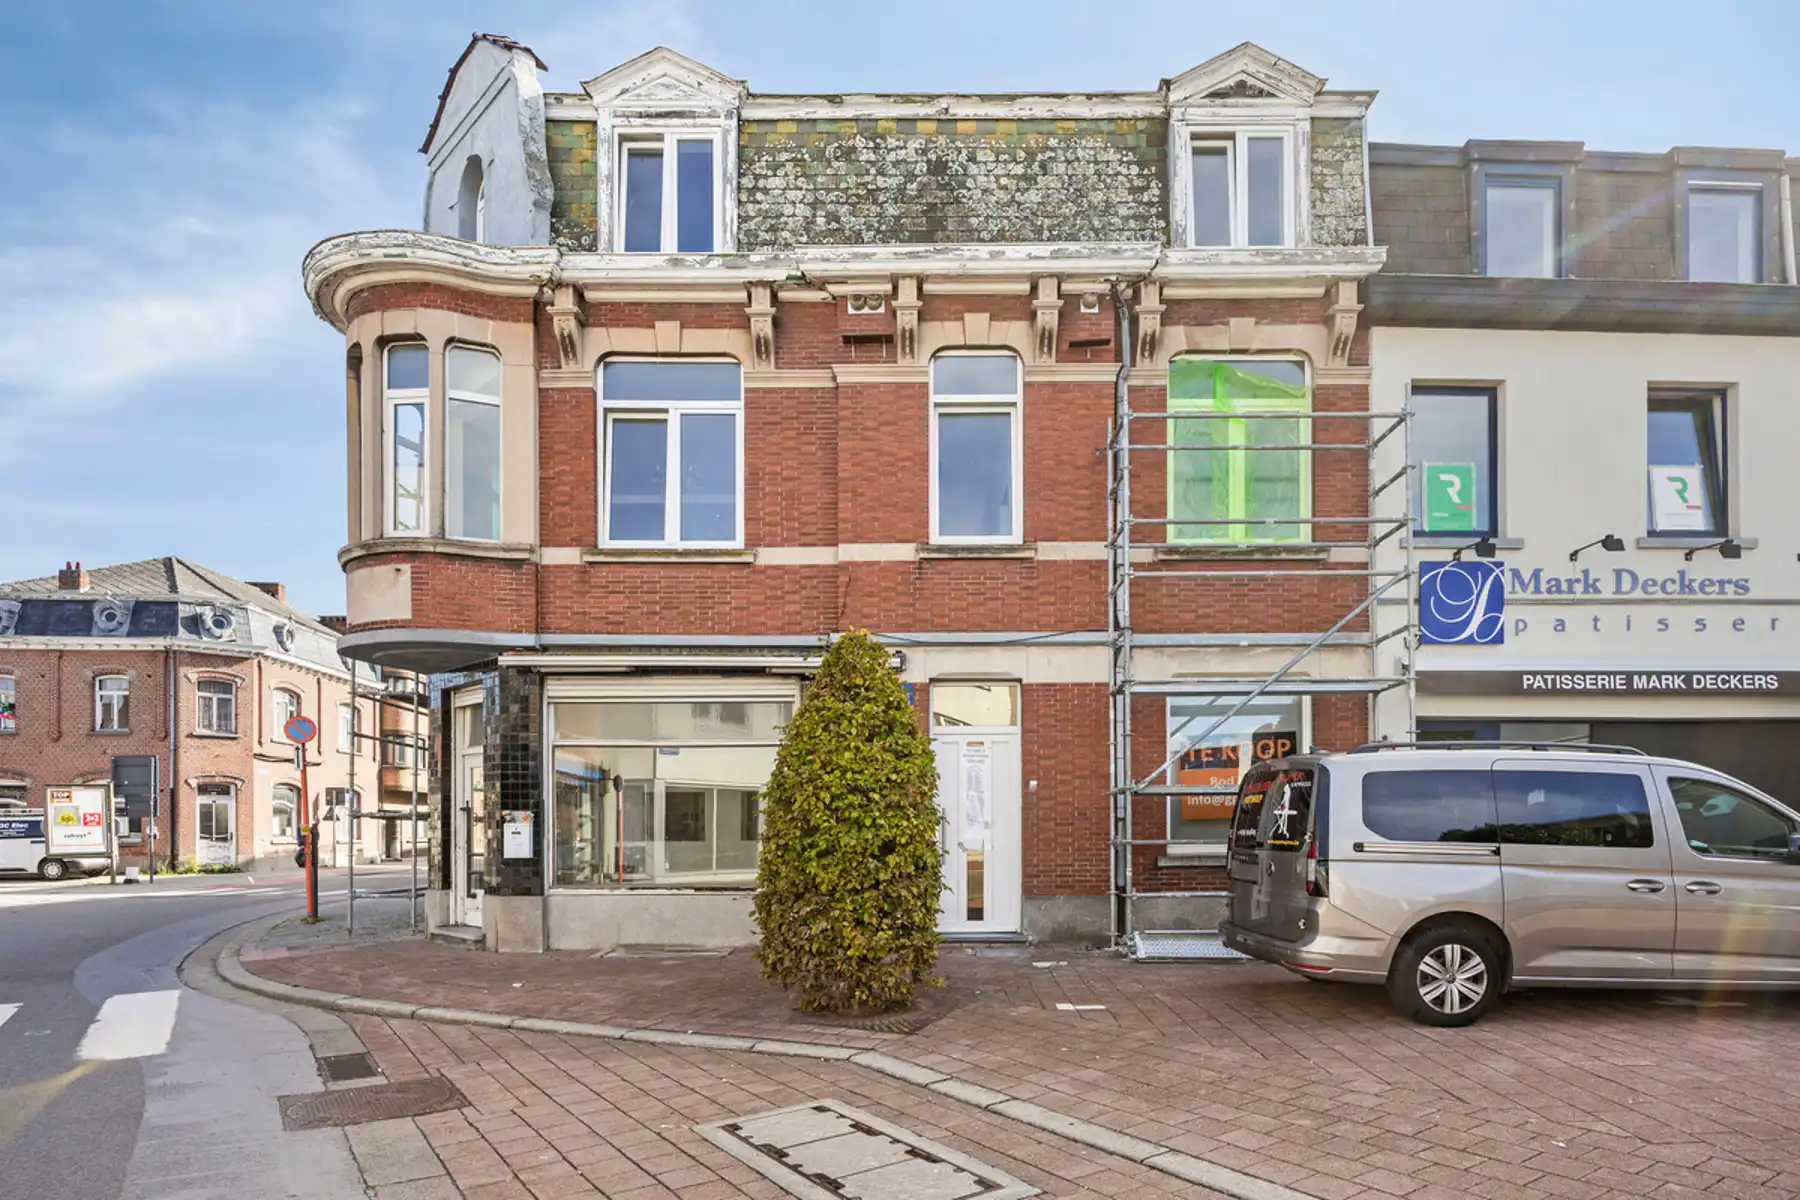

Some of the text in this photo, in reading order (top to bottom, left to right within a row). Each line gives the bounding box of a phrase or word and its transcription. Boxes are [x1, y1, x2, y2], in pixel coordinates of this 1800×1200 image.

[1508, 567, 1751, 597] Mark Deckers
[1514, 614, 1779, 637] patisser
[1522, 674, 1779, 690] PATISSERIE MARK DECKERS
[1221, 739, 1292, 761] KOP
